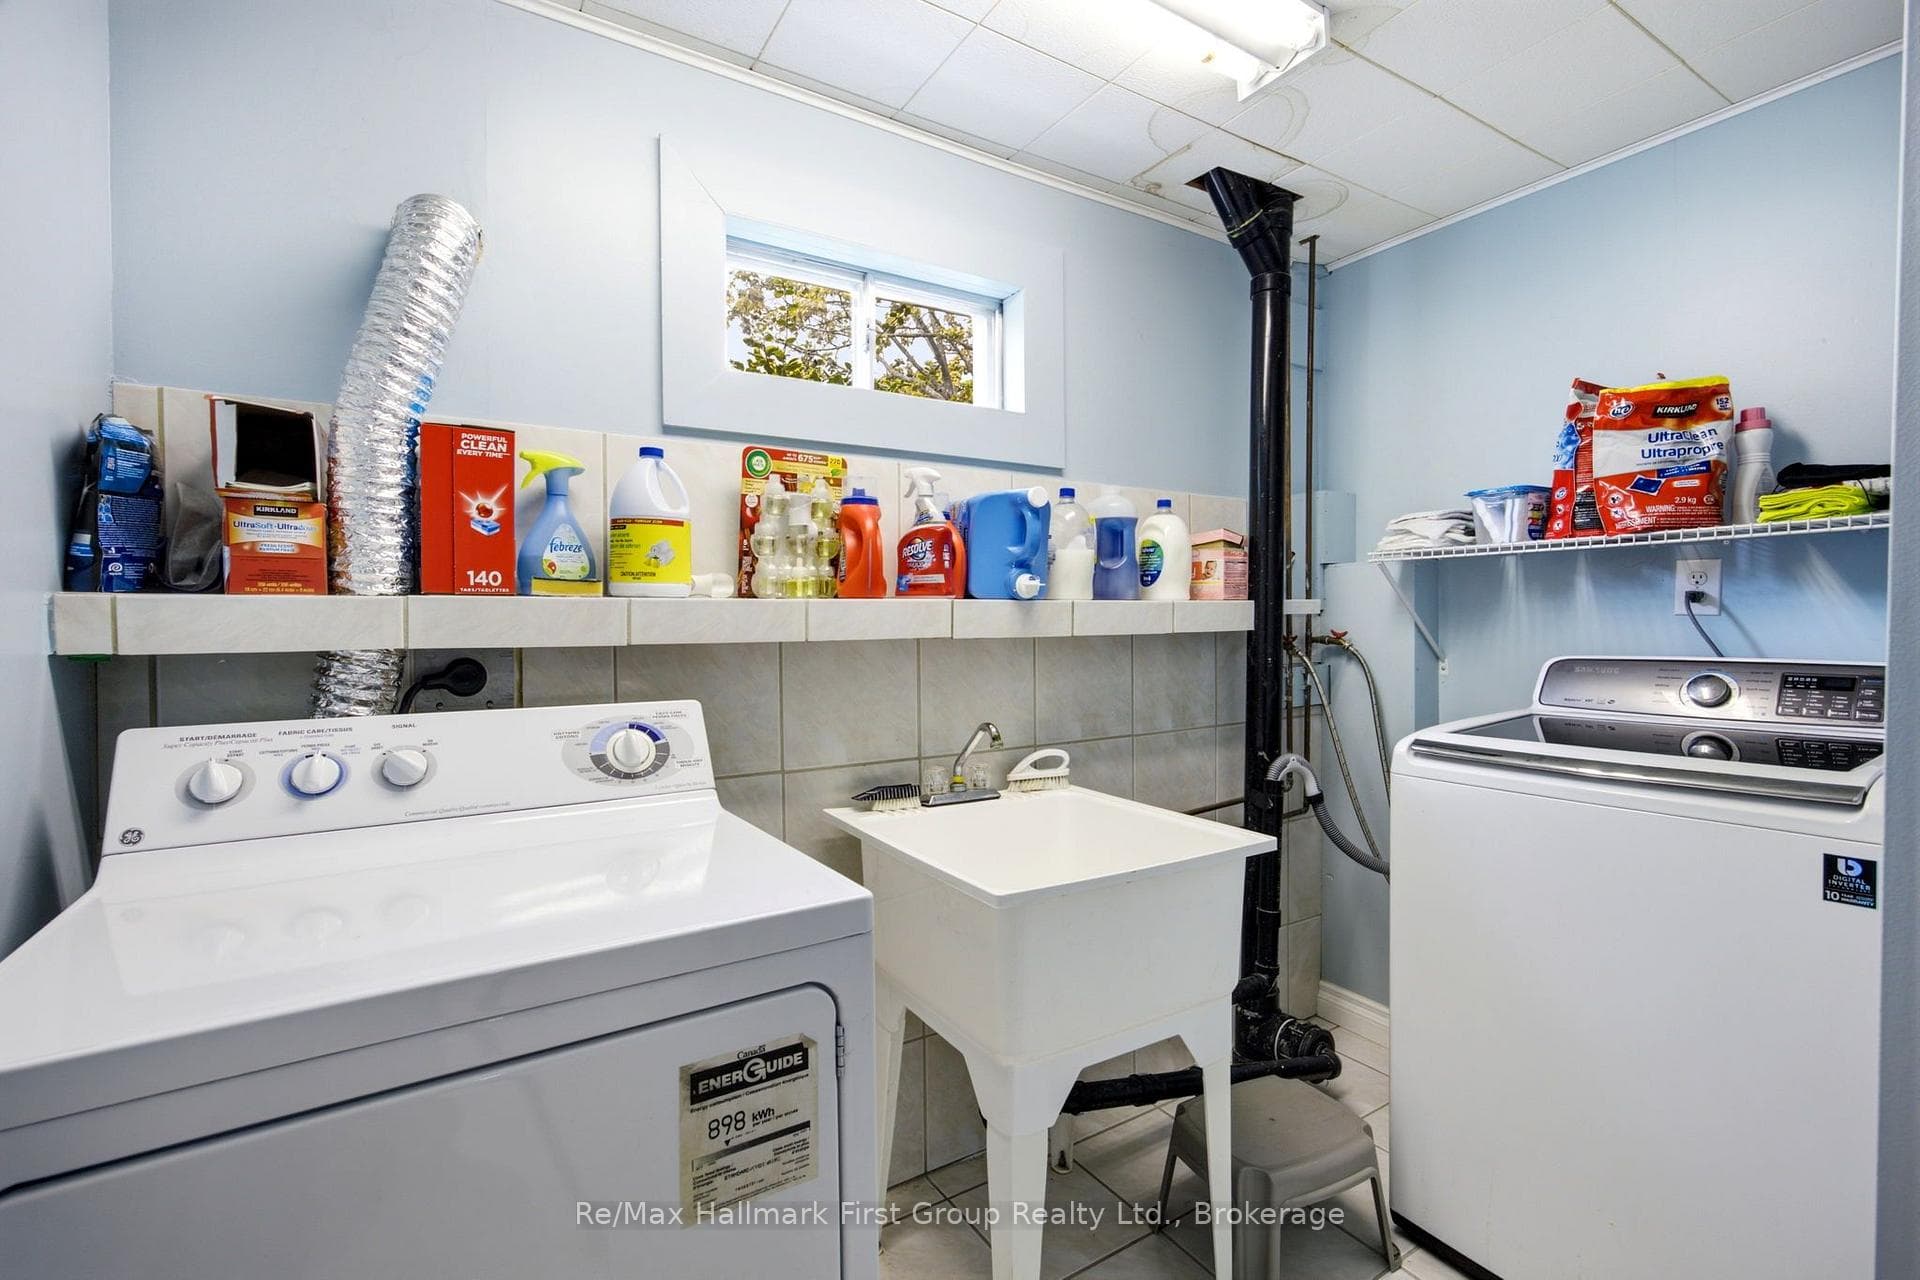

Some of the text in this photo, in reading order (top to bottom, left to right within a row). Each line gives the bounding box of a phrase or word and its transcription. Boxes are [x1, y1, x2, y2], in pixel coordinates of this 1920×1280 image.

[461, 433, 507, 444] POWERFUL
[1648, 428, 1718, 444] UltraClean
[460, 440, 507, 453] CLEAN
[456, 449, 505, 459] EVERY TIME
[797, 454, 814, 463] 675
[1674, 495, 1697, 505] 2.9 kg
[256, 506, 297, 514] KIRKLAND
[233, 521, 273, 530] UltraSoft
[550, 537, 583, 553] febreze
[903, 540, 933, 558] RESOLVE
[466, 570, 502, 586] 140
[278, 728, 305, 737] FABRIC
[1828, 879, 1871, 891] INVERTER
[1833, 875, 1866, 885] DIGITAL
[1825, 890, 1840, 901] 10
[752, 1107, 775, 1122] kWh
[708, 1110, 746, 1140] 898
